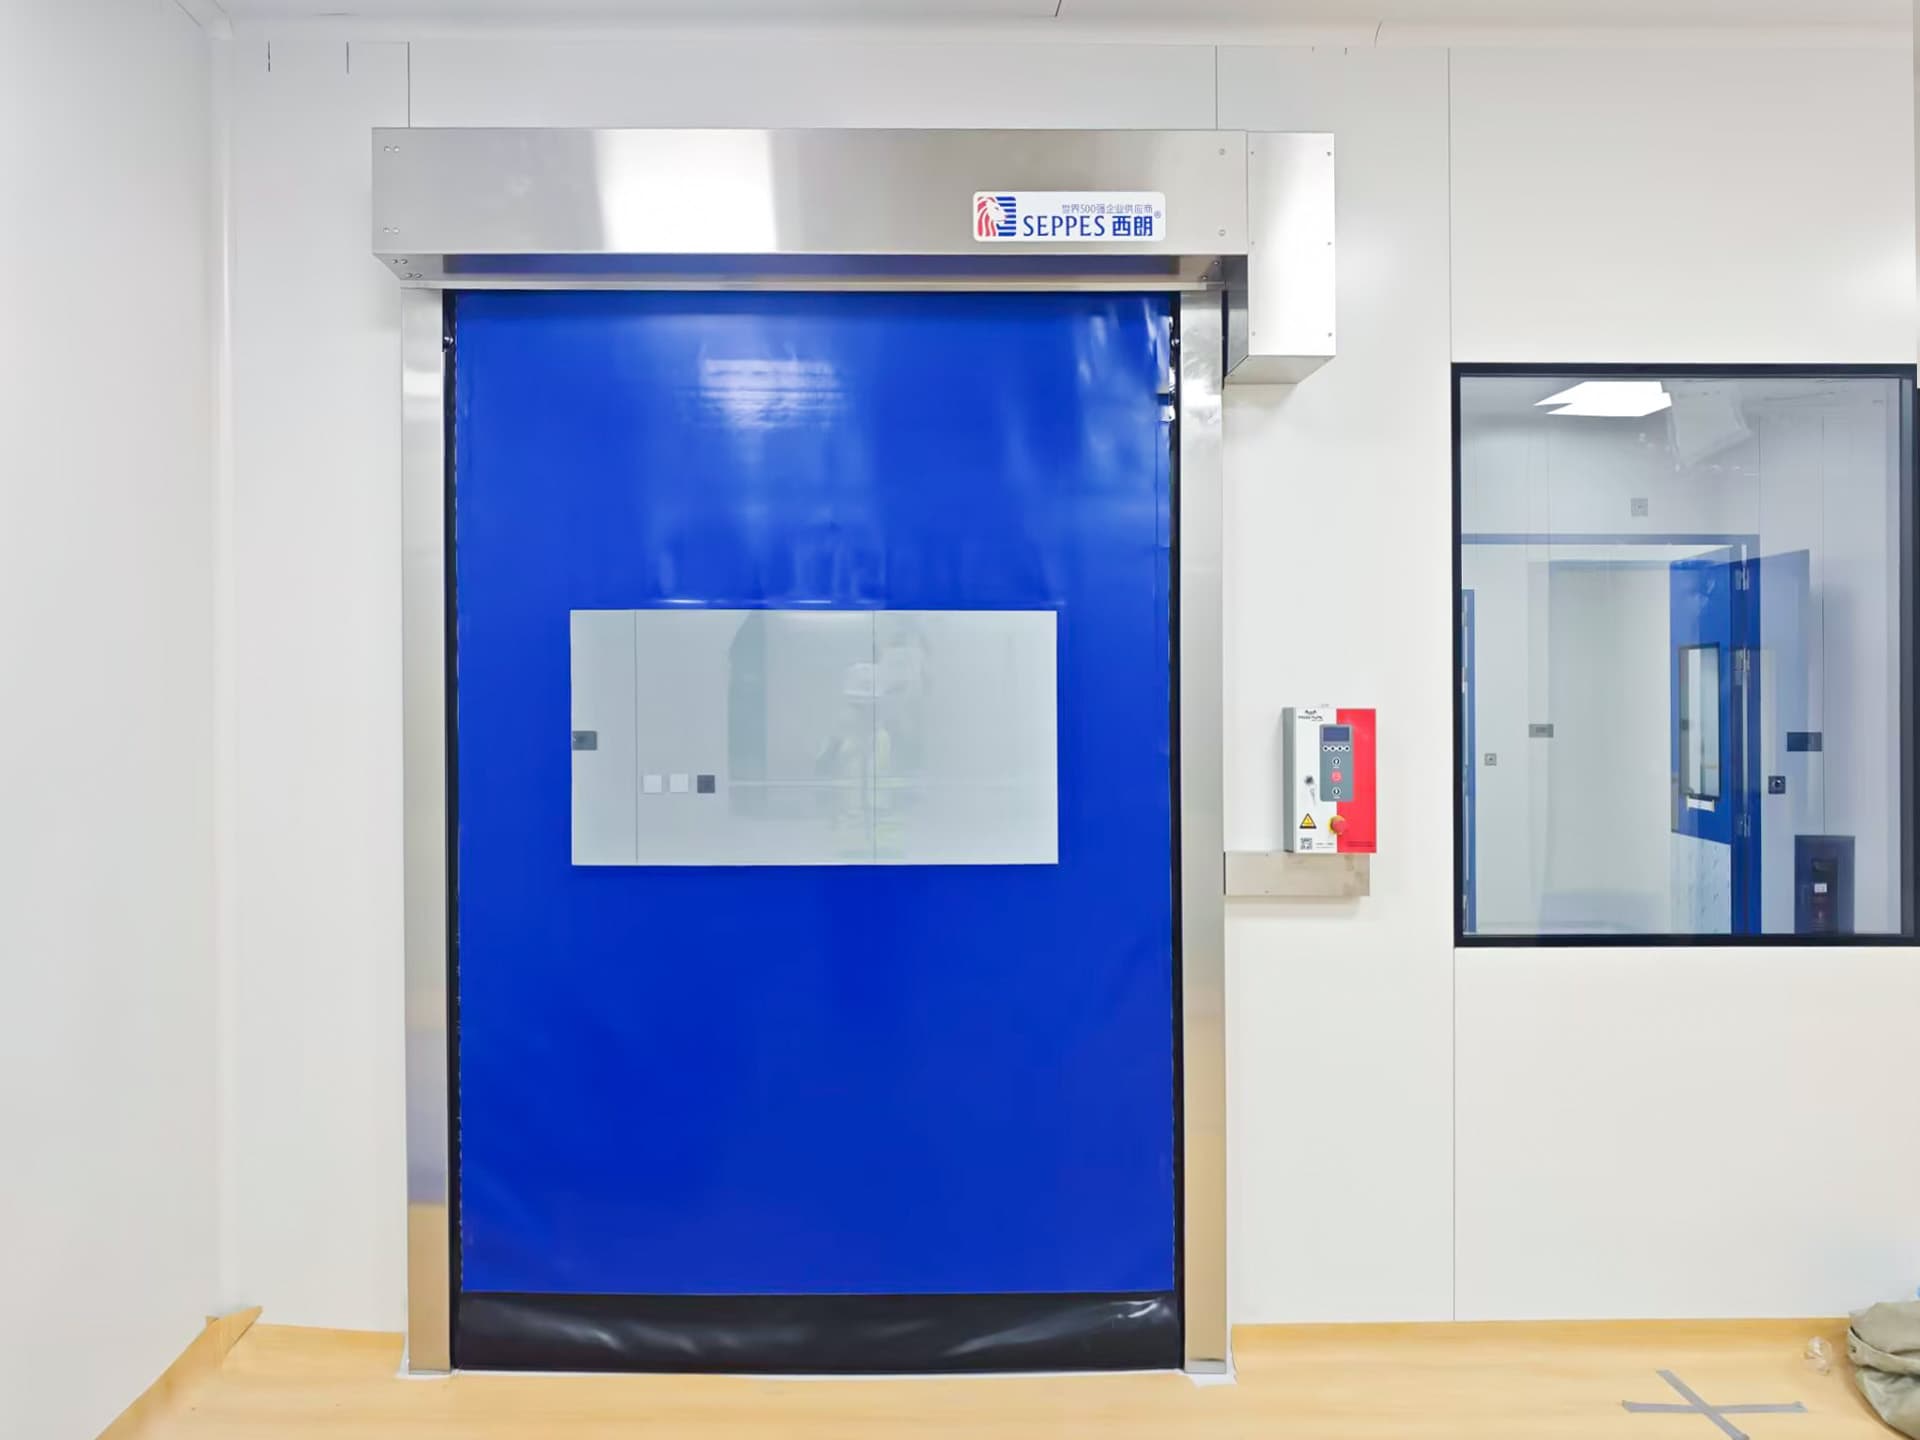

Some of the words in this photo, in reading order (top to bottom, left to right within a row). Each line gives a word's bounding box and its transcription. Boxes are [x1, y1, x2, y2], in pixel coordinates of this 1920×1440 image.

[1062, 203, 1153, 214] 世界500强企业供应商
[1023, 215, 1105, 237] SEPPES
